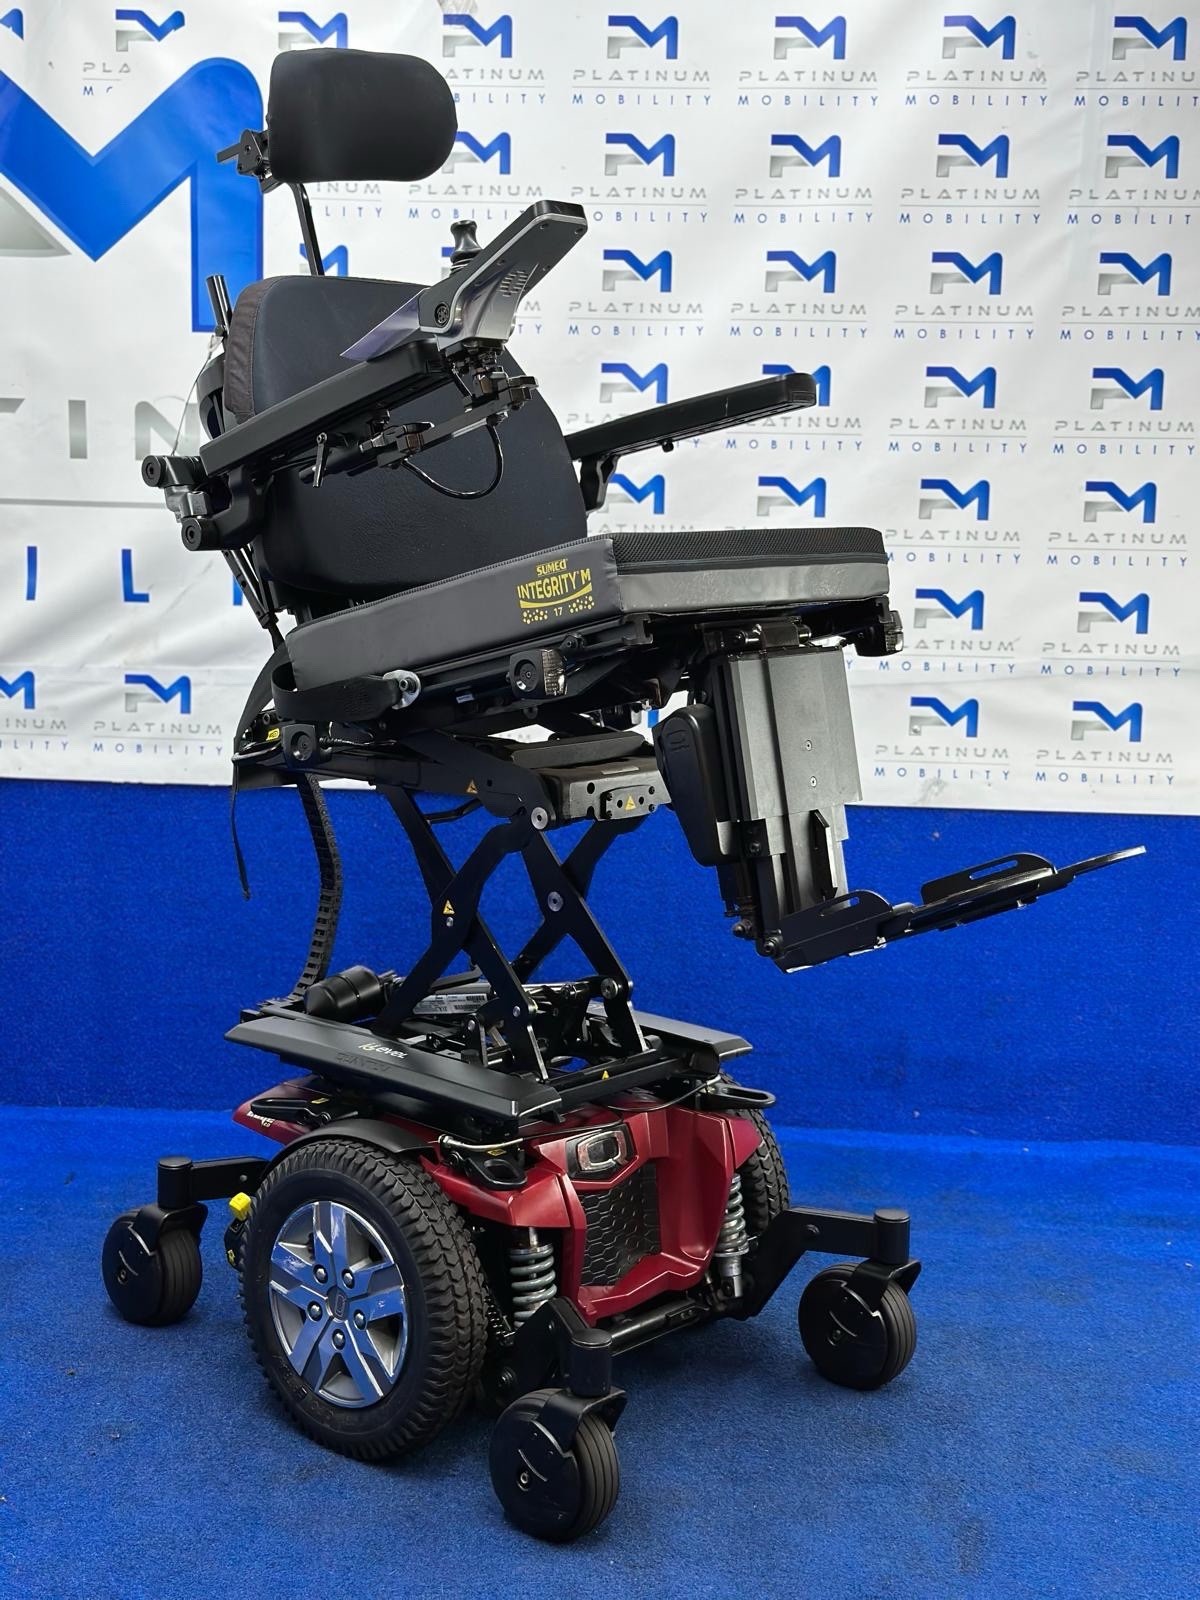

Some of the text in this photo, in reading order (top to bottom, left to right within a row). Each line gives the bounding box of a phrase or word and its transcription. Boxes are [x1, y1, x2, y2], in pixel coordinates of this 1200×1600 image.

[445, 69, 545, 81] ATINUM
[572, 70, 710, 82] PLATINUM
[738, 71, 878, 83] PLATINUM
[906, 70, 1047, 84] PLATINUM
[1075, 71, 1196, 83] PLATINU
[454, 92, 545, 105] BILITY
[571, 94, 711, 106] MOBILITY
[737, 95, 879, 107] MOBILITY
[904, 95, 1048, 107] MOBILITY
[1073, 95, 1199, 107] MOBILIT
[408, 185, 543, 197] PLATINUM
[570, 187, 707, 199] PLATINUM
[735, 188, 873, 200] PLATINUM
[900, 188, 1041, 201] PLATINUM
[593, 211, 708, 224] OBILITY
[734, 212, 873, 224] MOBILITY
[898, 213, 1041, 225] MOBILITY
[1066, 214, 1192, 225] MOBILIT
[568, 302, 703, 314] PLATINUM
[730, 303, 867, 315] PLATINUM
[895, 305, 1033, 317] PLATINUM
[567, 325, 704, 337] MOBILITY
[729, 326, 868, 338] MOBILITY
[893, 329, 1035, 340] MOBILITY
[745, 416, 862, 429] ATINUM
[889, 418, 1027, 430] PLATINUM
[1054, 421, 1195, 433] PLATINUM
[725, 439, 863, 451] MOBILITY
[888, 441, 1028, 453] MOBILITY
[1052, 444, 1196, 456] MOBILITY
[884, 529, 1021, 541] PLATINUM
[1047, 532, 1187, 545] PLATINUM
[1047, 555, 1188, 568] MOBILITY
[517, 571, 577, 599] INTEGRITY
[903, 640, 1015, 652] ATINUM
[1042, 642, 1180, 656] PLATINUM
[878, 661, 1016, 674] MOBILITY
[1041, 664, 1181, 677] MOBILITY
[94, 721, 222, 735] PLATINUM
[93, 743, 223, 755] MOBILITY
[875, 745, 1010, 759] PLATINUM
[1036, 750, 1173, 764] PLATINUM
[873, 767, 1010, 781] MOBILITY
[1035, 772, 1175, 786] MOBILITY
